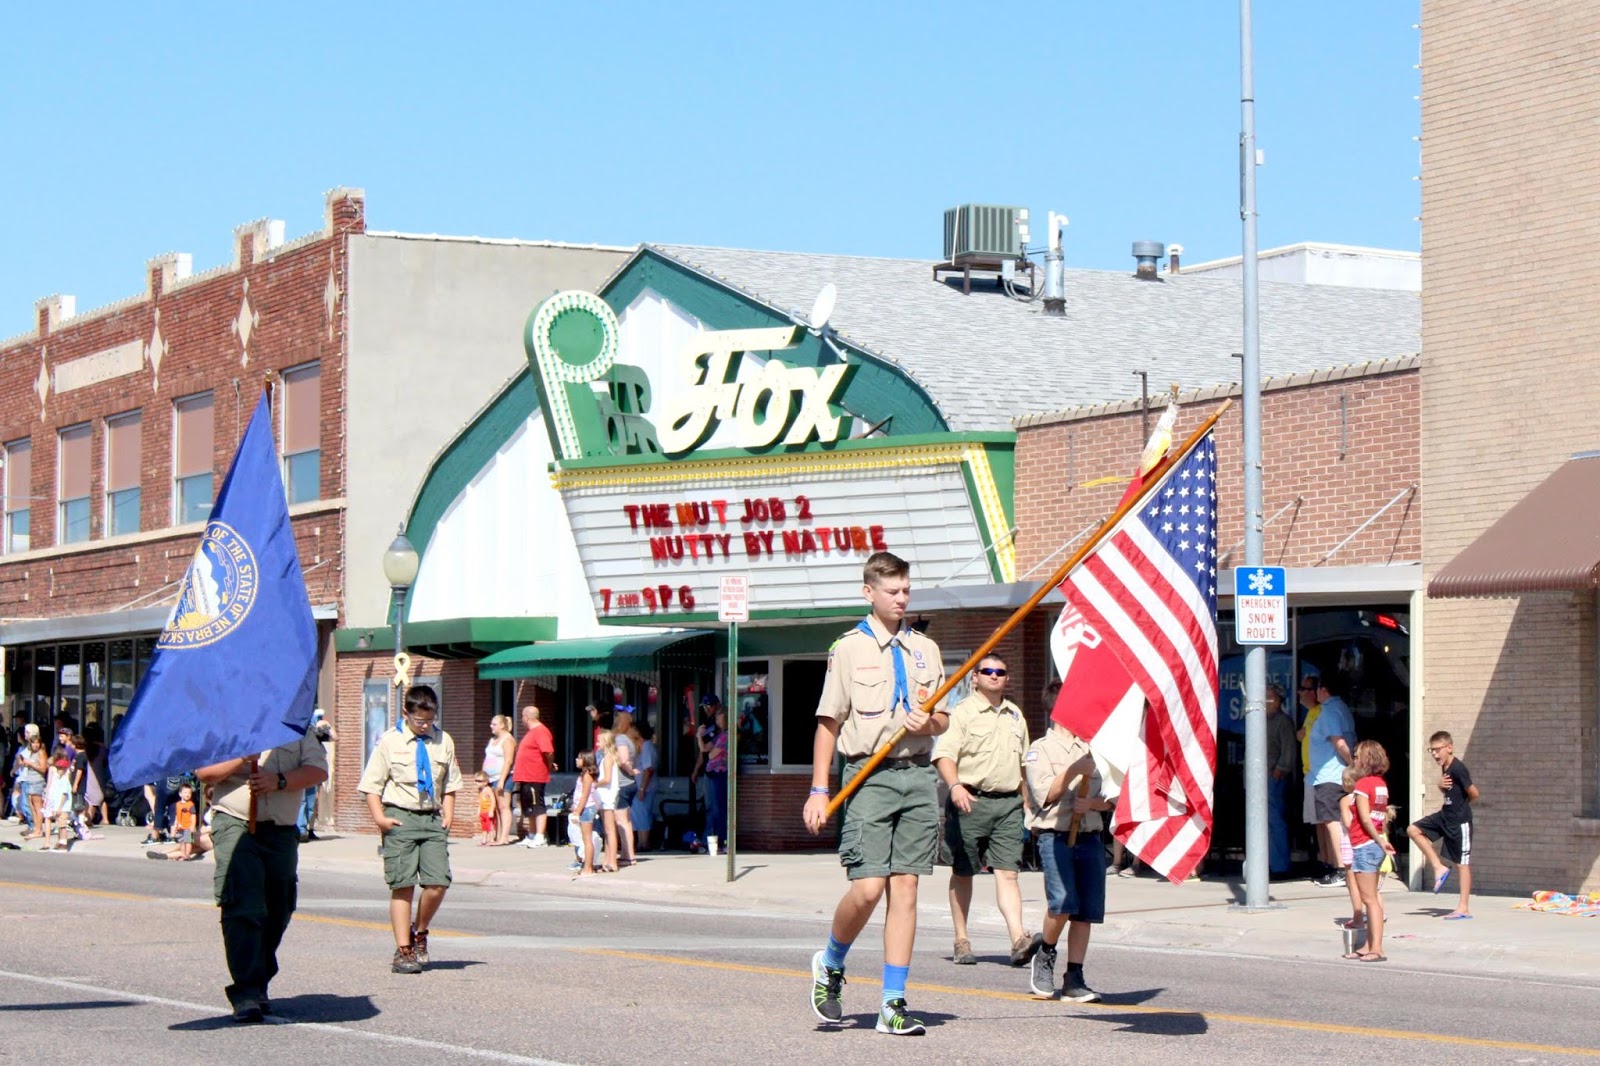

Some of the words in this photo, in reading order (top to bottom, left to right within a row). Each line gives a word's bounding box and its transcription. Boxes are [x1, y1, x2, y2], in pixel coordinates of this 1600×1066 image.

[623, 504, 673, 529] THE
[676, 500, 729, 528] NUT
[740, 497, 786, 523] JOB
[795, 495, 813, 519] 2
[211, 527, 229, 541] OF
[650, 533, 731, 560] NUTTY
[743, 530, 774, 556] BY
[782, 525, 888, 554] NATURE
[227, 539, 247, 562] THE
[239, 565, 251, 603] STATE
[599, 588, 612, 612] 7
[642, 587, 658, 612] 9
[1240, 598, 1281, 609] EMERGENCY
[233, 604, 244, 620] OF
[1248, 613, 1275, 624] SNOW
[1246, 627, 1276, 639] ROUTE
